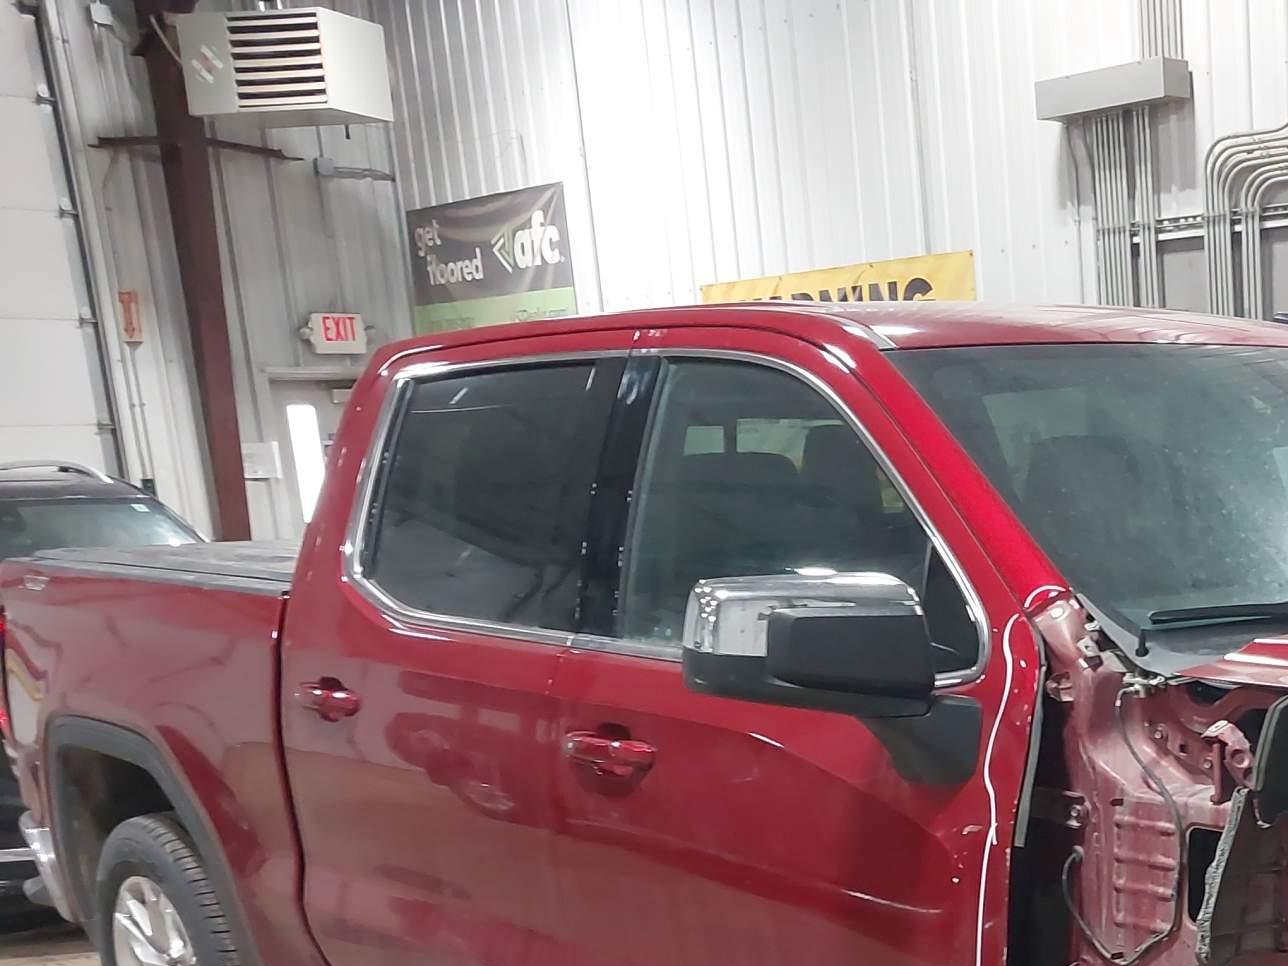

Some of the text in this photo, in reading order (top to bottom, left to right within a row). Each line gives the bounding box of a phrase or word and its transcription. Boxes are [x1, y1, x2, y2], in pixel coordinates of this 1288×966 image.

[415, 219, 441, 256] get
[427, 248, 484, 285] floored
[322, 316, 356, 341] EXIT
